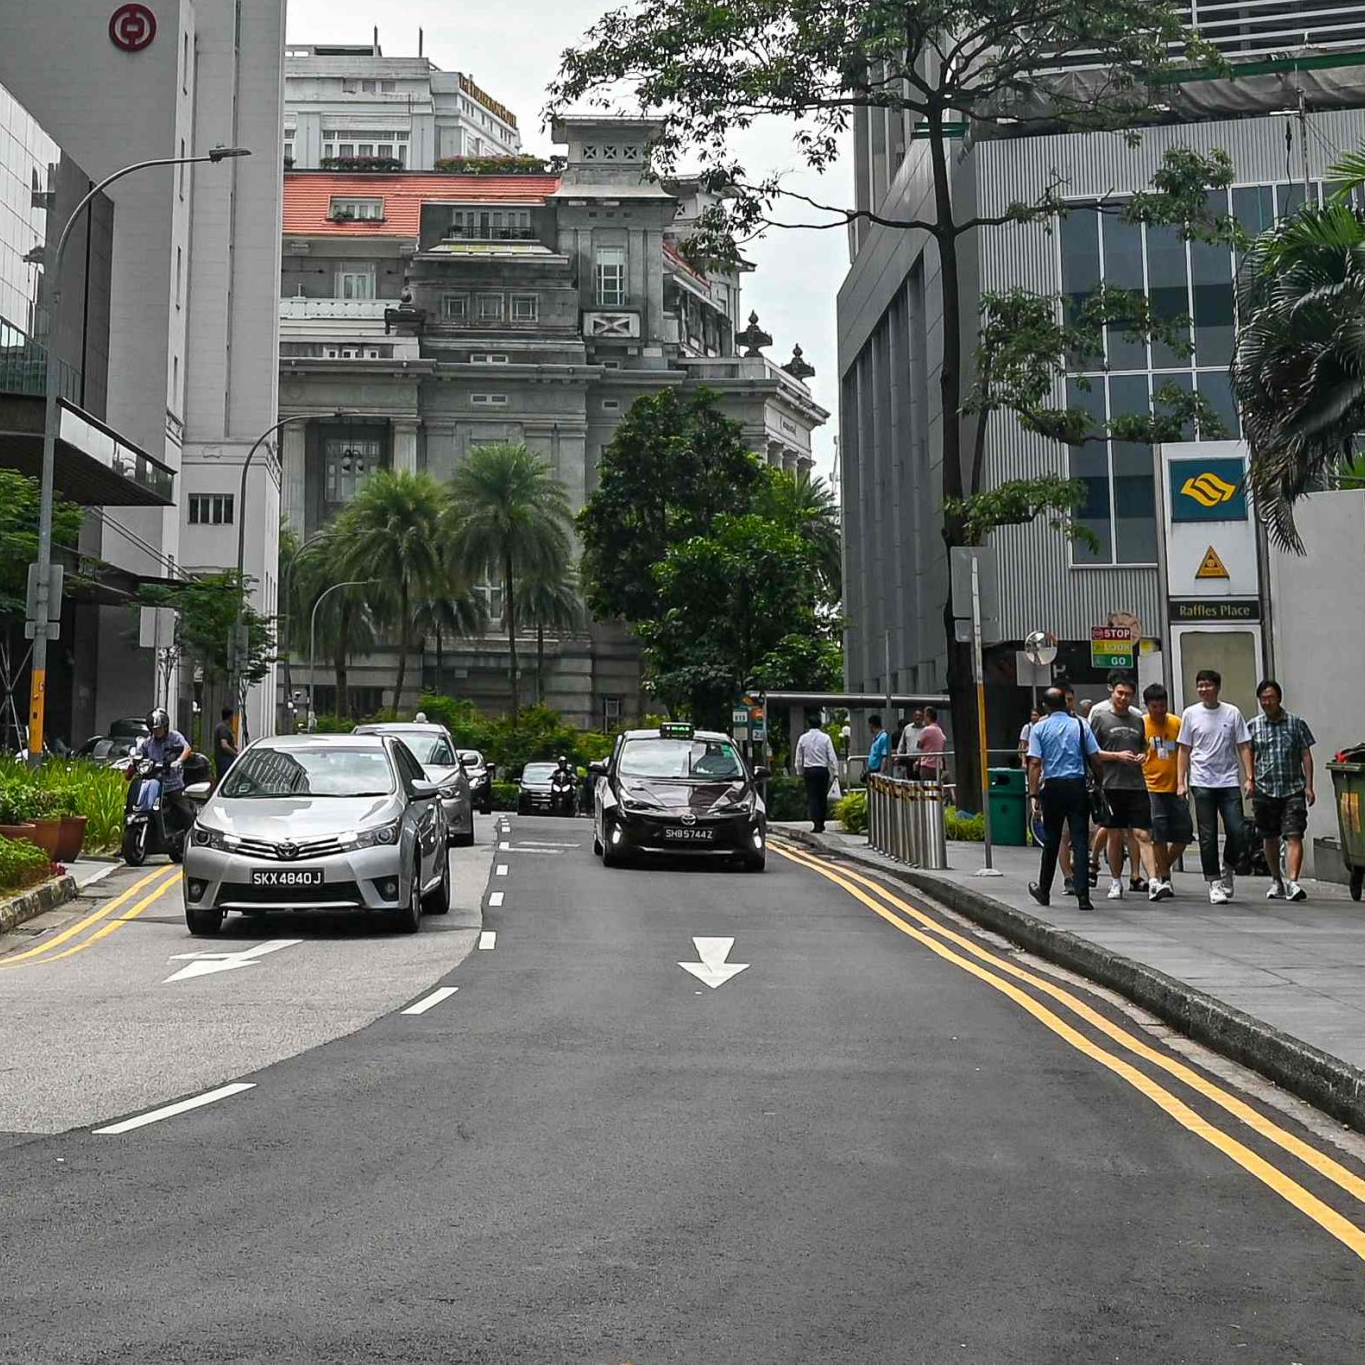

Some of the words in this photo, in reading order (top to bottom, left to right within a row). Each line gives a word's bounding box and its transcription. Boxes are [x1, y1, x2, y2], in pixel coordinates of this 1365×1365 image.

[1179, 605, 1217, 616] Raffles
[1220, 604, 1251, 616] Place
[1104, 629, 1130, 638] STOP
[1111, 656, 1126, 666] GO
